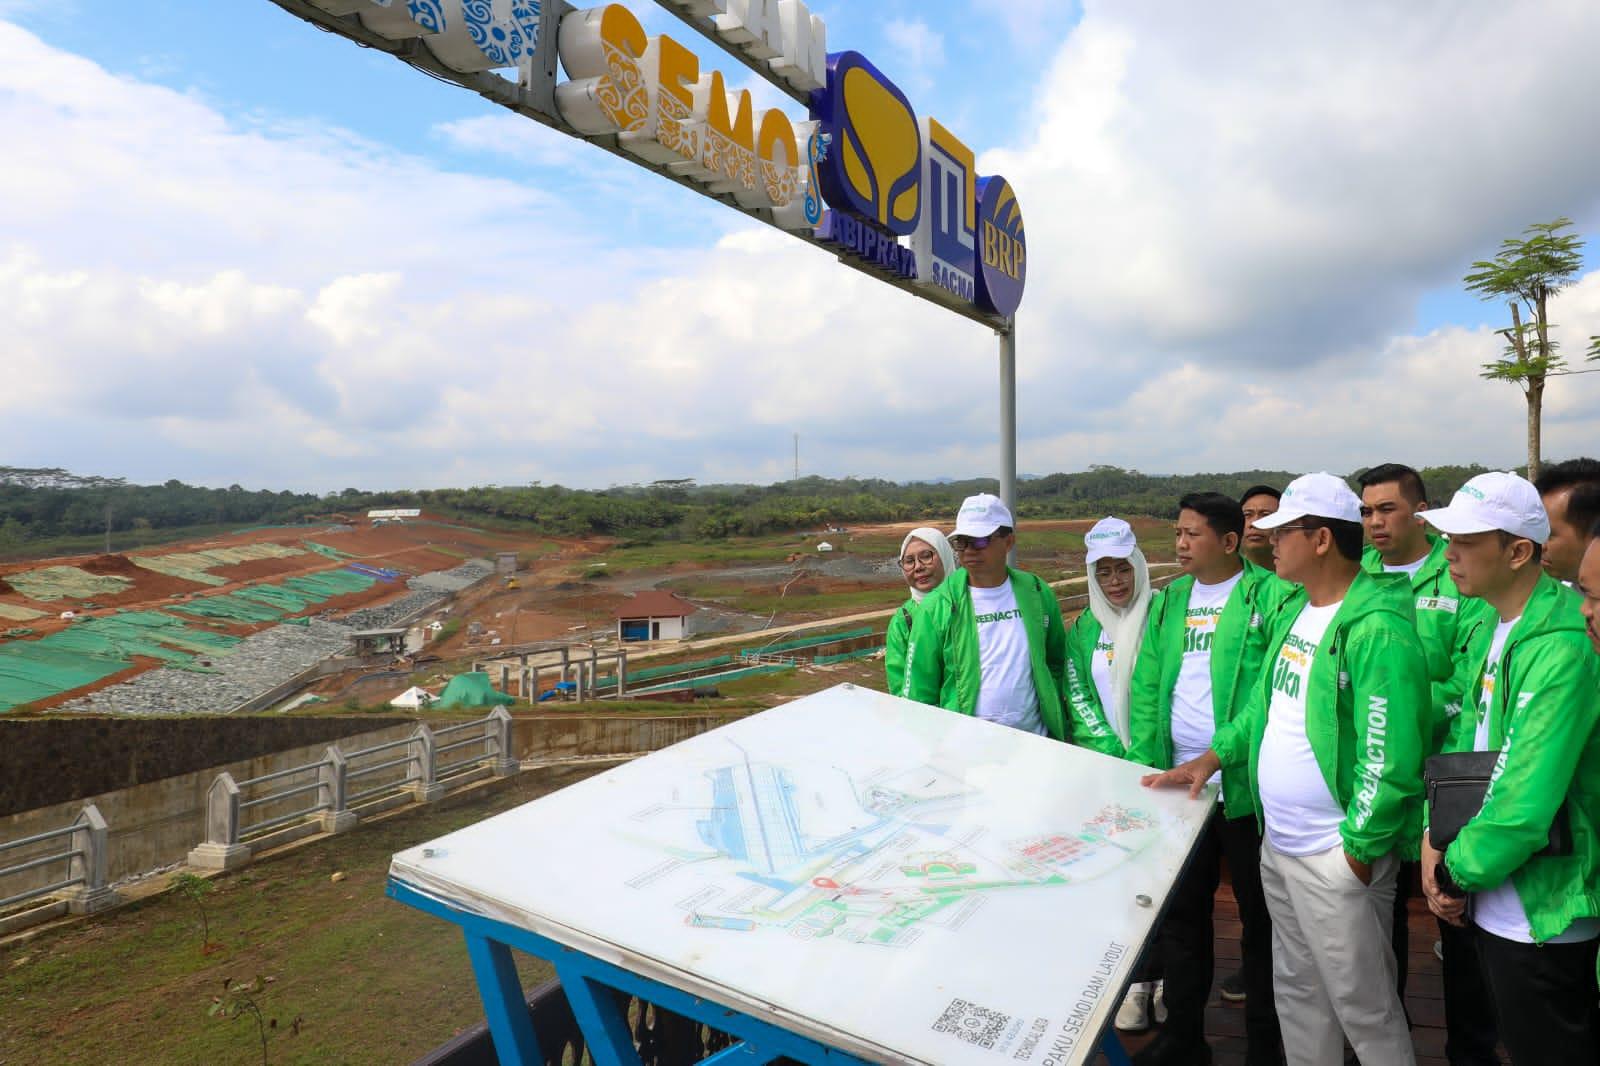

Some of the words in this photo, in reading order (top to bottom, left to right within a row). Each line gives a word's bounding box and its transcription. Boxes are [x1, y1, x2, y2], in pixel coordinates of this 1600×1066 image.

[829, 210, 918, 280] ABIPRAYA
[983, 219, 1024, 280] BRP
[1042, 1034, 1074, 1066] PAKU
[1063, 995, 1093, 1035] SEMOI
[1081, 974, 1107, 1001] DAM
[1097, 940, 1125, 978] LAYOUT
